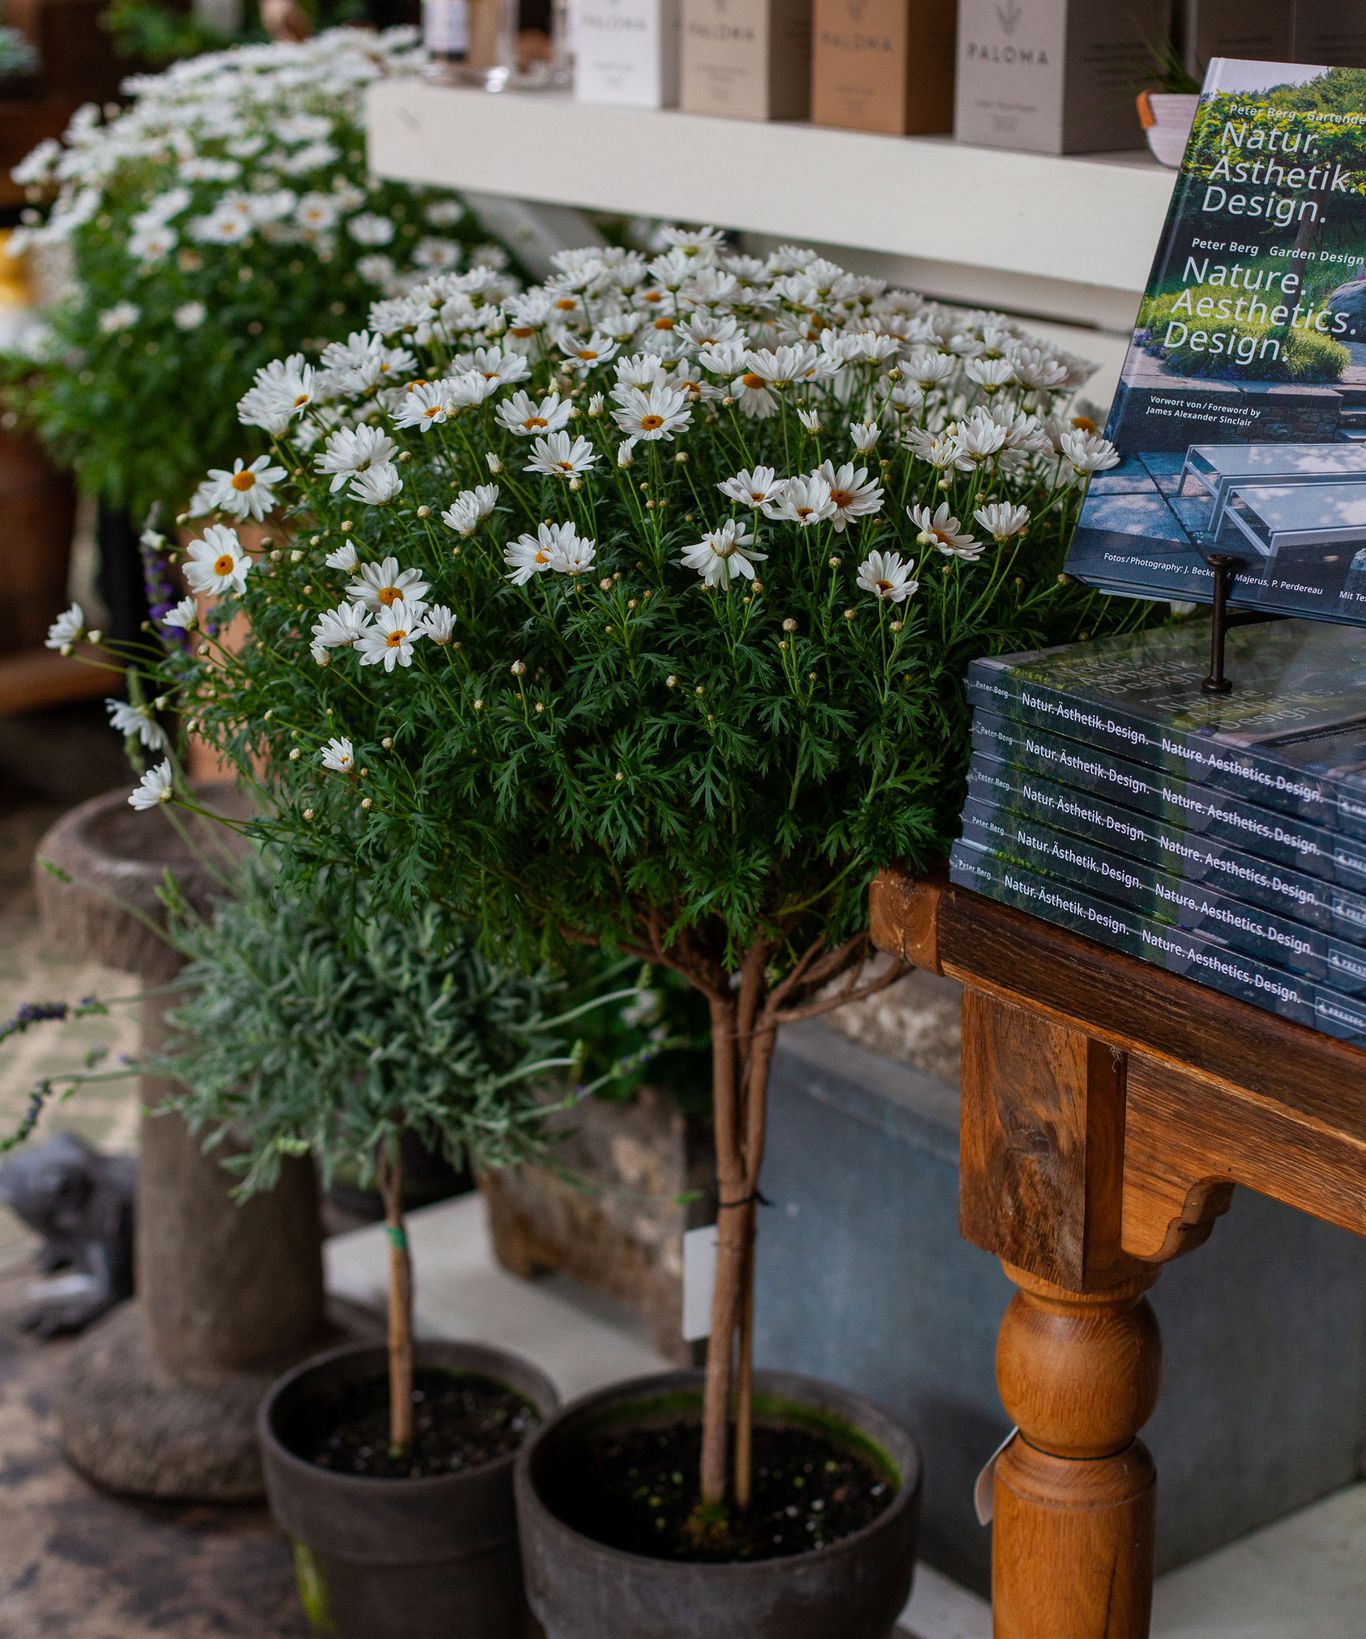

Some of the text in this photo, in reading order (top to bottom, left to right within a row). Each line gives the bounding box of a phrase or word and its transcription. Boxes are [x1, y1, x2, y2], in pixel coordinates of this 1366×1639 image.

[967, 42, 1049, 65] PALOMA
[1229, 104, 1263, 116] Peter
[1267, 107, 1297, 122] Berg
[1220, 121, 1319, 155] Natur.
[1208, 149, 1357, 194] Ästhetik.
[1202, 185, 1327, 227] Design.
[1191, 237, 1364, 267] Peter Berg Garden Design
[1182, 256, 1307, 296] Nature.
[1170, 288, 1357, 335] Aesthetics.
[1163, 320, 1288, 365] Design.
[1145, 406, 1252, 427] James Alexander Sinclair
[1150, 395, 1184, 407] Vorwort
[1250, 408, 1261, 419] by
[1192, 566, 1216, 578] Becke
[1235, 574, 1269, 588] Majerus,
[1271, 579, 1278, 588] P.
[1280, 581, 1323, 595] Perdereau
[1339, 590, 1353, 600] Mit
[975, 680, 1324, 804] Peter Berg Natur. Ästhetik. Design. Nature. Aesthetics. Design.
[1026, 739, 1058, 762] Natur.
[1060, 749, 1107, 779] Ästhetik.
[1109, 768, 1150, 794] Design.
[1162, 787, 1205, 814] Nature.
[1207, 804, 1273, 839] Aesthetics.
[1274, 827, 1321, 856] Design.
[977, 771, 994, 784] Peter
[995, 778, 1010, 791] Berg
[1023, 785, 1055, 808] Natur.
[1056, 795, 1104, 826] Ästhetik.
[1106, 815, 1148, 842] Design.
[1160, 835, 1203, 862] Nature.
[1205, 853, 1270, 888] Aesthetics.
[1272, 877, 1318, 905] Design.
[972, 816, 988, 828] Peter
[989, 822, 1005, 836] Berg
[1017, 830, 1050, 853] Natur.
[1052, 841, 1099, 873] Ästhetik.
[1101, 862, 1143, 889] Design.
[1155, 884, 1198, 911] Nature.
[1200, 902, 1266, 937] Aesthetics.
[1267, 927, 1314, 956] Design.
[1004, 875, 1037, 898] Natur.
[1038, 886, 1086, 918] Ästhetik.
[1088, 908, 1129, 935] Design.
[1142, 929, 1185, 957] Nature.
[1187, 948, 1252, 984] Aesthetics.
[1254, 974, 1301, 1004] Design.
